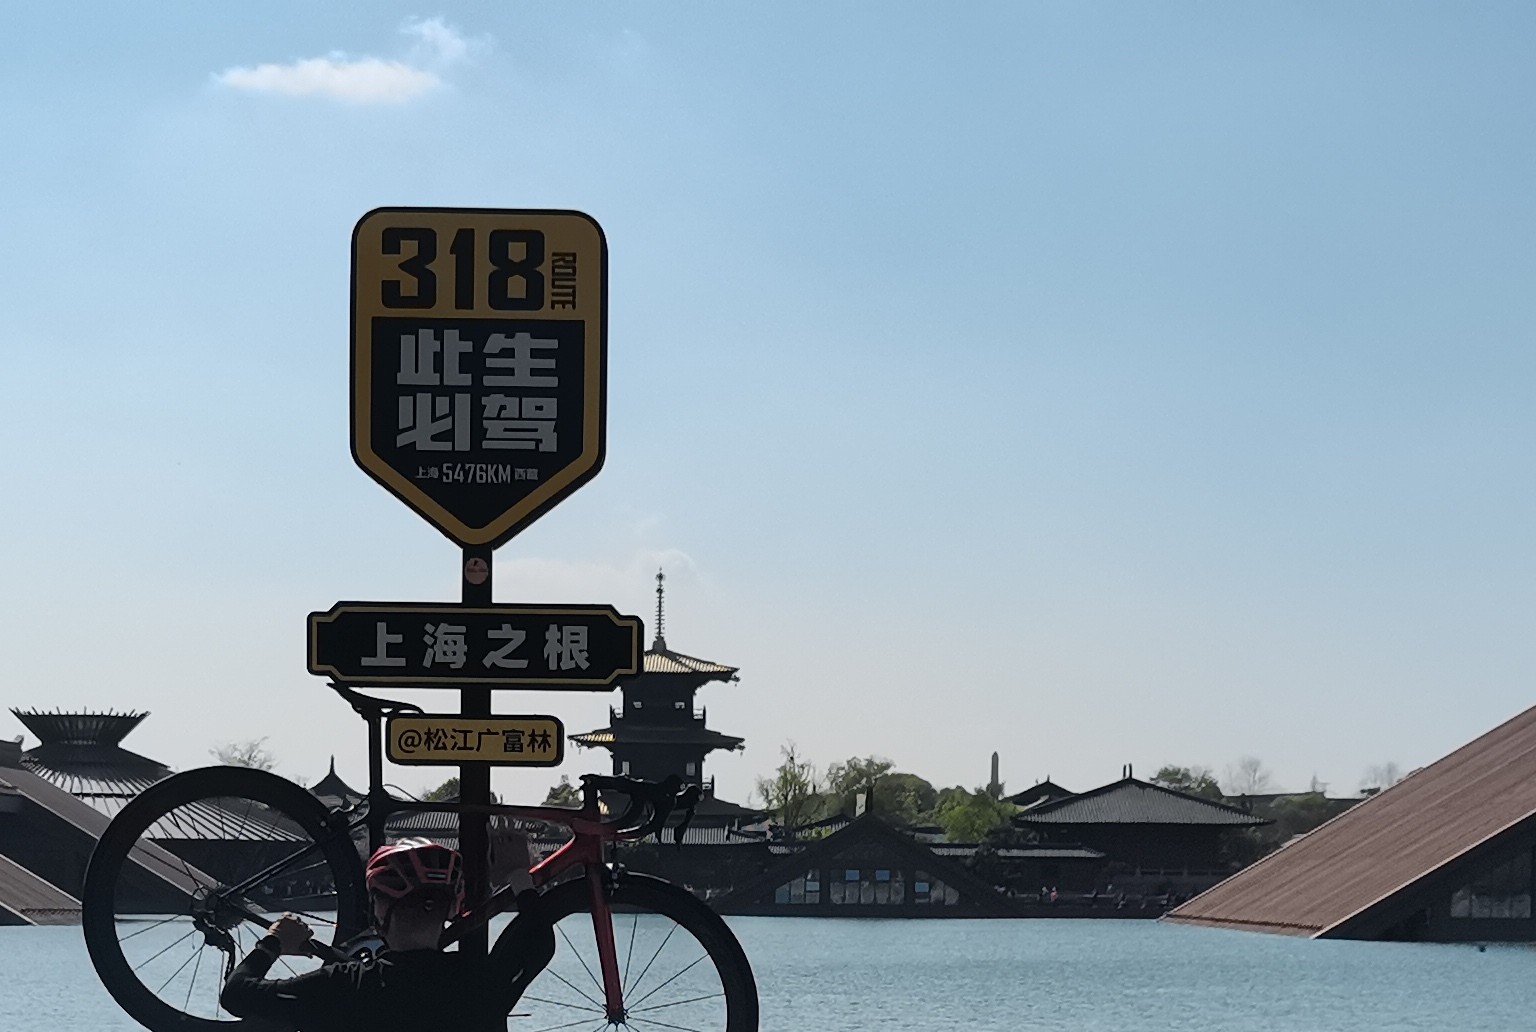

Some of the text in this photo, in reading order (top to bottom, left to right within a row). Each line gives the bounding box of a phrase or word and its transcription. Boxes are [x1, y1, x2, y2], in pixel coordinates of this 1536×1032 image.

[381, 228, 545, 310] 318
[550, 251, 577, 311] ROUTE
[396, 327, 559, 388] 此生
[396, 391, 558, 453] 必驾
[442, 462, 512, 485] 5476KM
[360, 620, 591, 671] 上海之根
[398, 728, 552, 754] @松江广富林
